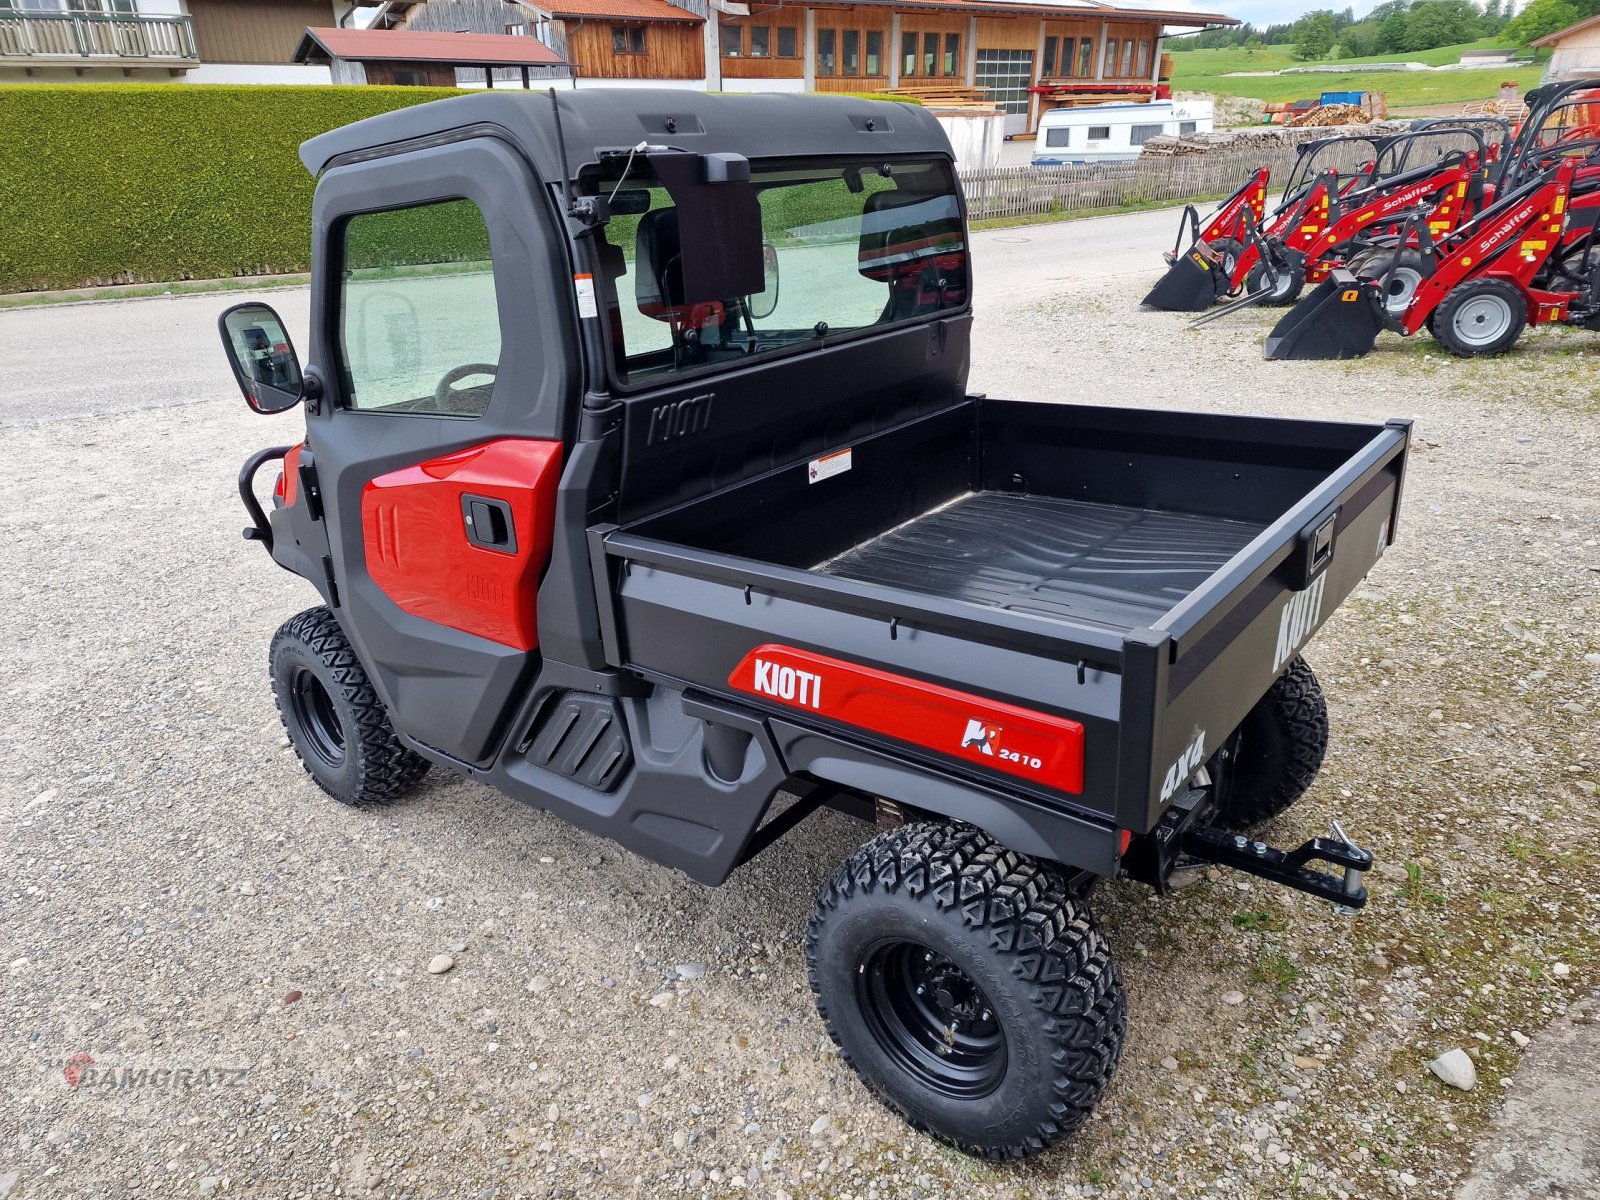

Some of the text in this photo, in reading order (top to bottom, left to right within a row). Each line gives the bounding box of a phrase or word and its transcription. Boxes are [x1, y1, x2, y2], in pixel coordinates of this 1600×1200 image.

[1384, 183, 1434, 212] Schäffer
[1480, 205, 1534, 253] Schäffer
[754, 658, 822, 709] KIOTI
[998, 748, 1042, 769] 2410
